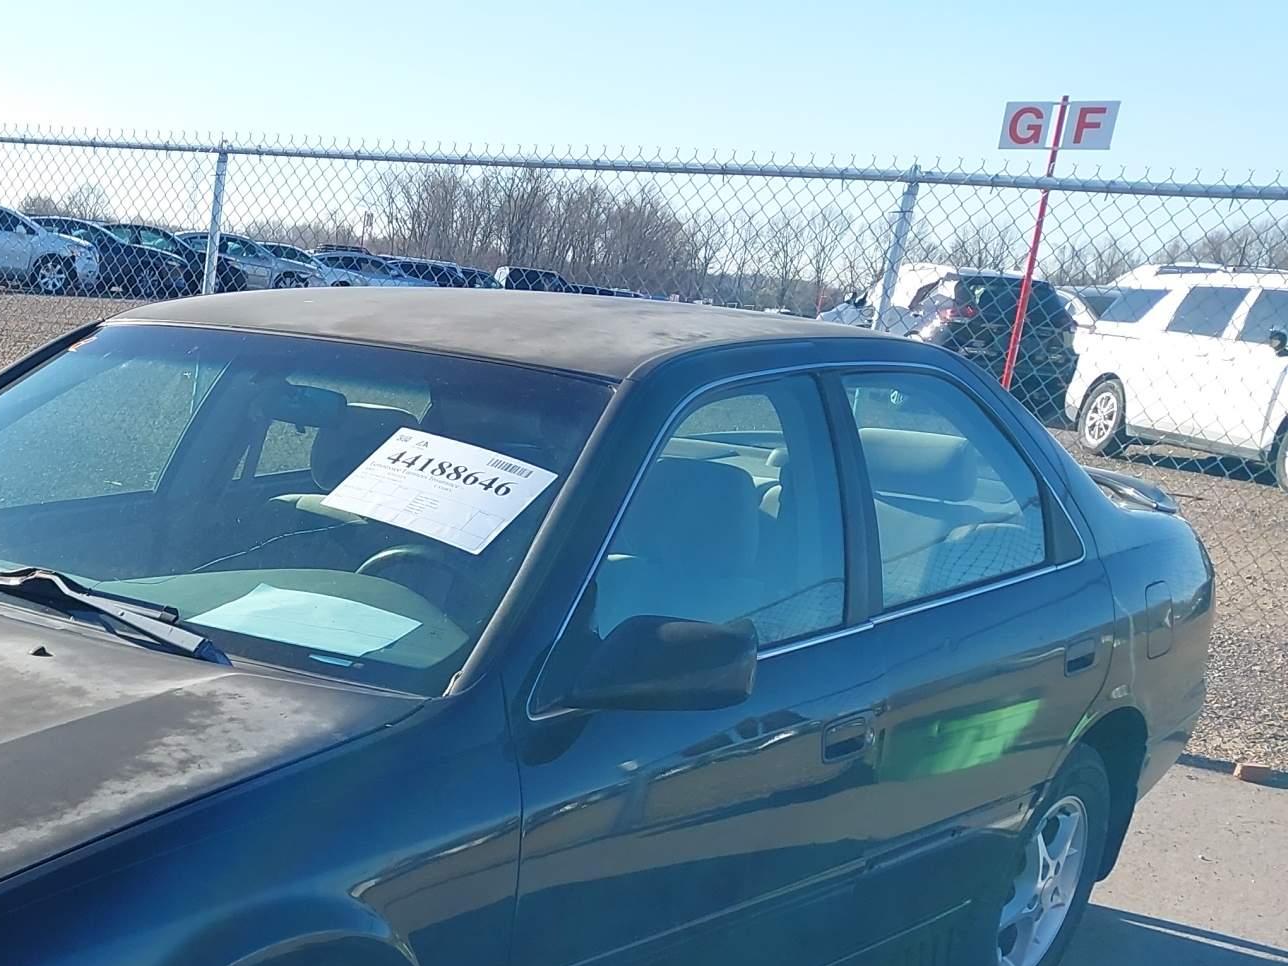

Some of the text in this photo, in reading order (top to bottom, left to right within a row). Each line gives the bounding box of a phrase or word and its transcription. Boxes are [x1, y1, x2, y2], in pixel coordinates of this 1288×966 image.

[1008, 106, 1044, 145] G
[1072, 106, 1108, 144] F
[387, 450, 519, 497] 44188646
